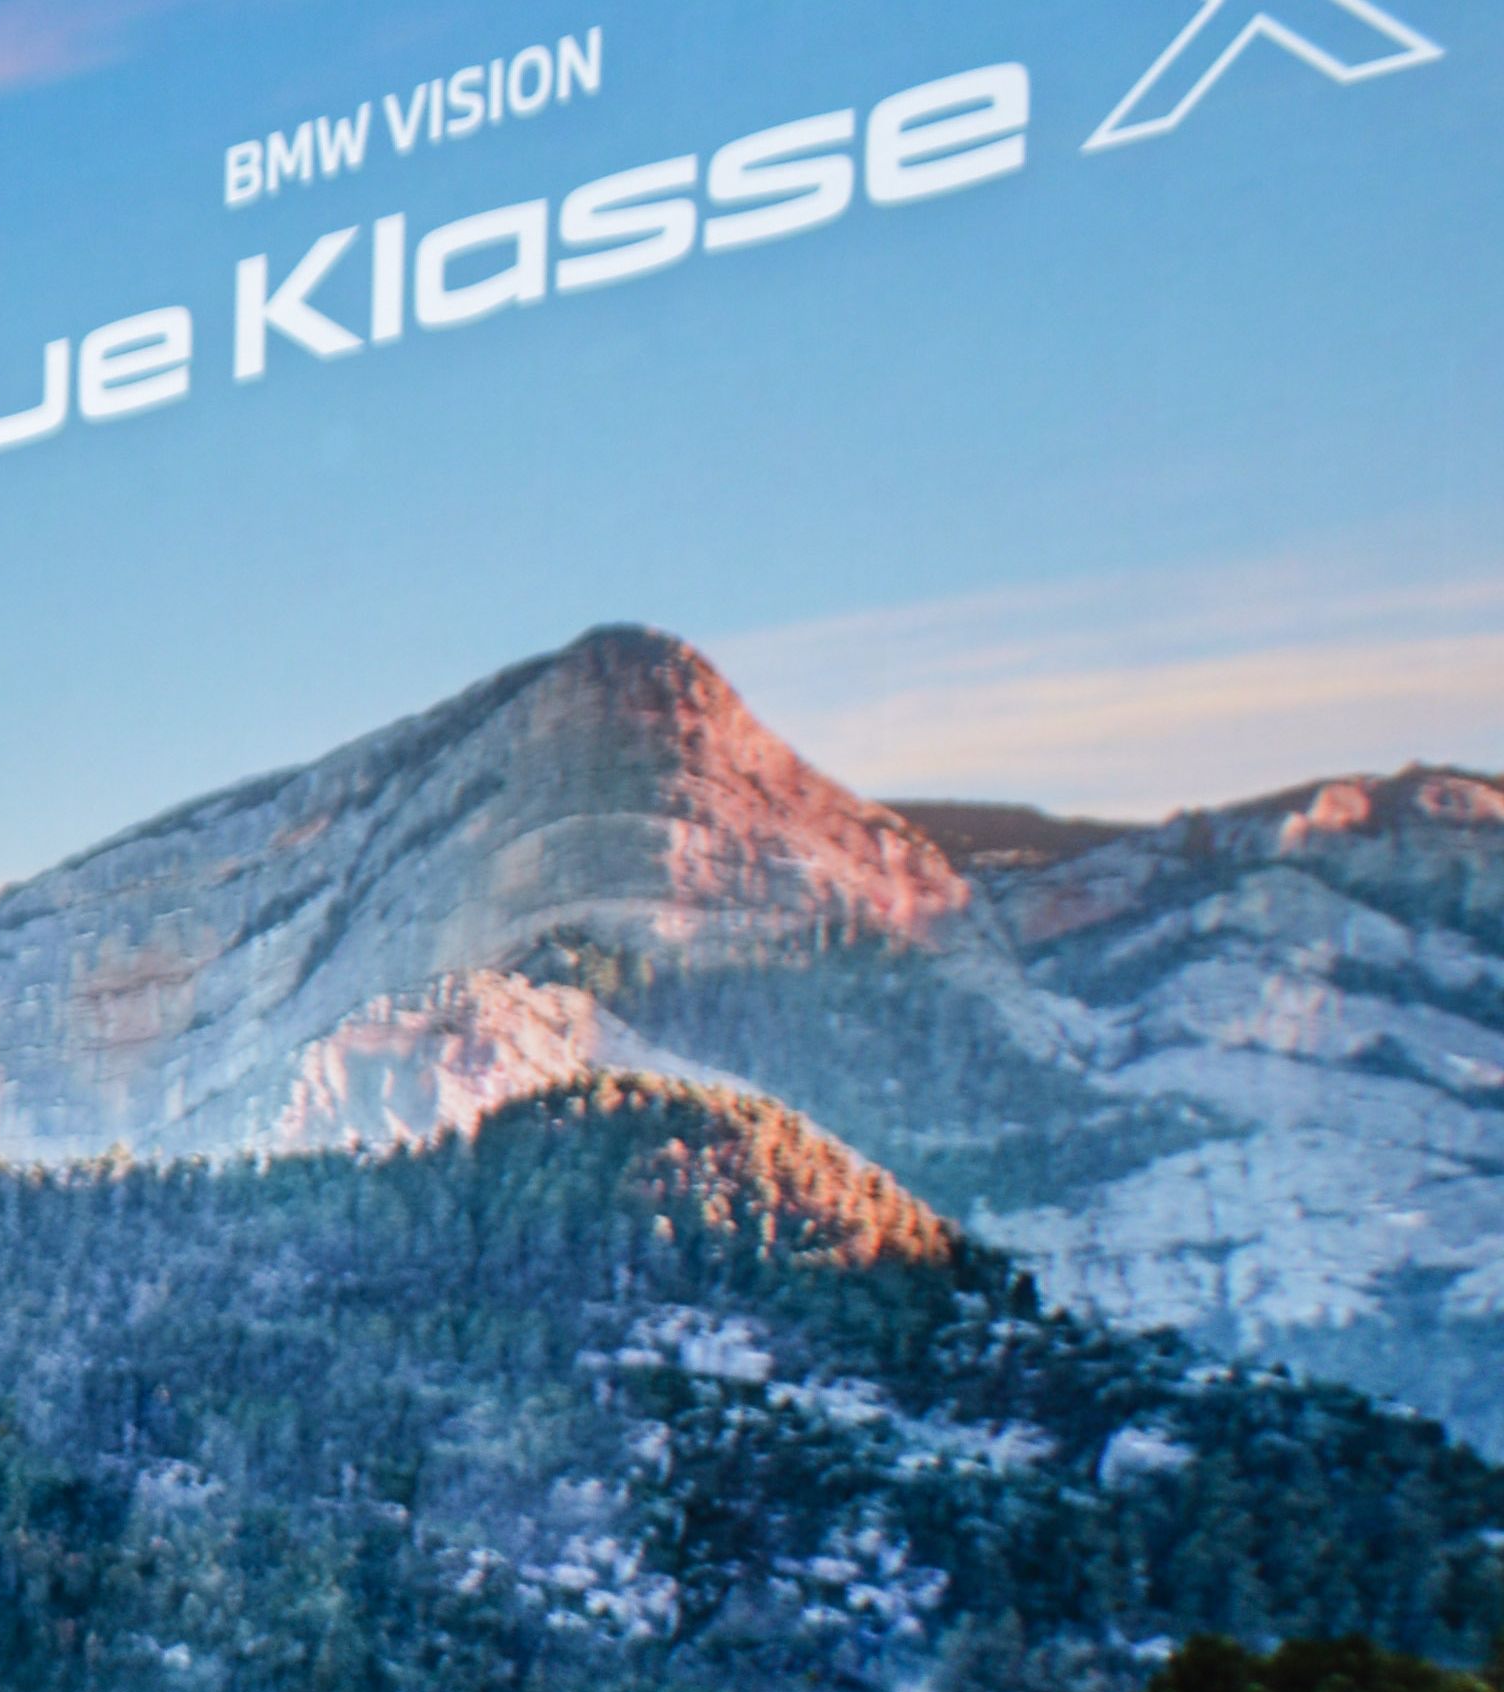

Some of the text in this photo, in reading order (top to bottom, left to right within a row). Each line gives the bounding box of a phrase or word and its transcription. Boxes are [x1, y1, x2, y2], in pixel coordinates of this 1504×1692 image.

[225, 26, 602, 207] BMW VISION
[233, 61, 1031, 381] Klasse
